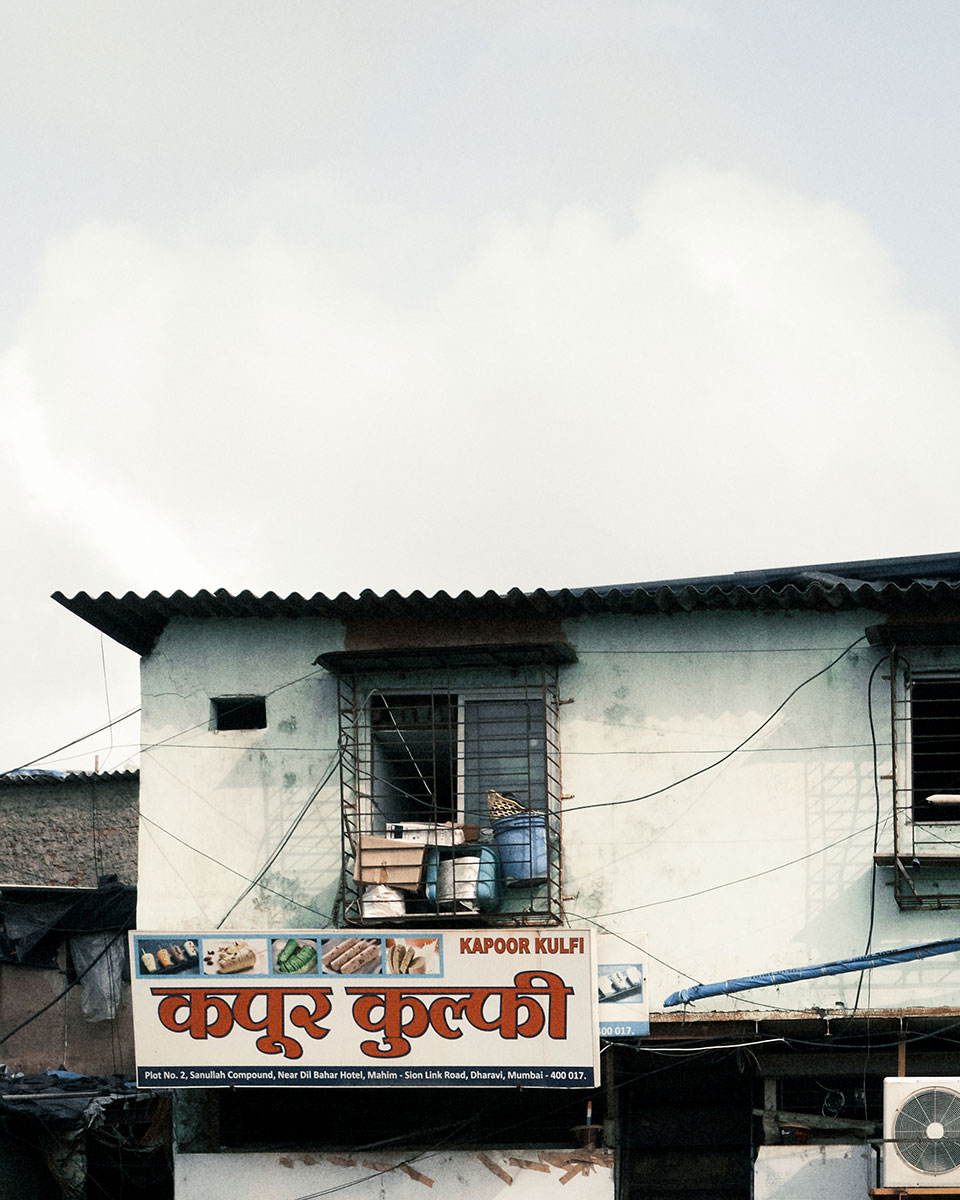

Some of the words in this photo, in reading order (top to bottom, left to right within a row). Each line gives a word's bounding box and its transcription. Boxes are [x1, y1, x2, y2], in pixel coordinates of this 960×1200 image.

[460, 937, 530, 954] KAPOOR
[535, 937, 584, 954] KULFI
[150, 987, 333, 1060] कपूर
[344, 970, 575, 1058] कुल्फी
[599, 1026, 613, 1035] 00
[614, 1026, 635, 1035] 017.
[145, 1071, 162, 1080] Plot
[164, 1071, 178, 1080] No.
[180, 1071, 188, 1082] 2,
[190, 1071, 226, 1080] Sanullah
[227, 1071, 276, 1082] Compound,
[277, 1071, 298, 1080] Near
[300, 1071, 312, 1080] Dil
[313, 1071, 338, 1080] Bahar
[340, 1071, 366, 1082] Hotel,
[367, 1071, 397, 1080] Mahim
[404, 1071, 423, 1080] Sion
[425, 1071, 443, 1080] Link
[444, 1071, 469, 1082] Road,
[470, 1071, 506, 1082] Dharavi,
[507, 1071, 543, 1080] Mumbai
[550, 1071, 566, 1080] 400
[568, 1071, 587, 1080] 017.
